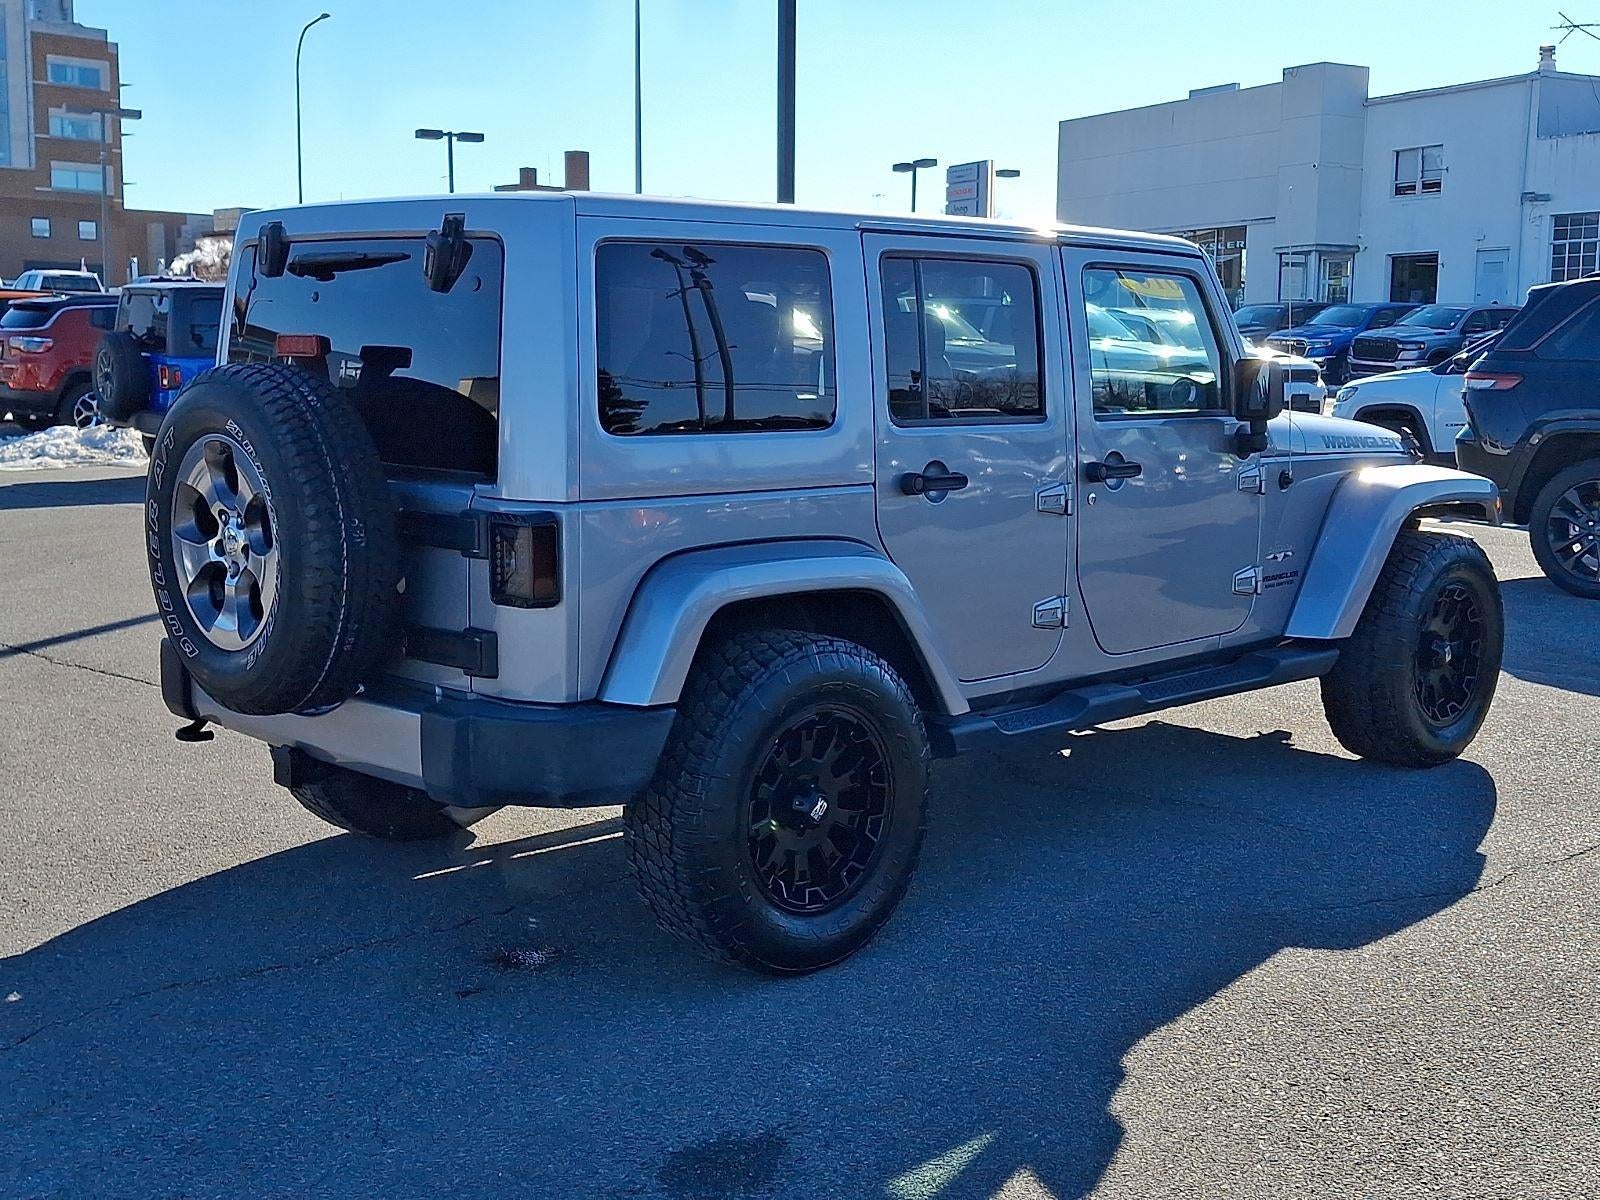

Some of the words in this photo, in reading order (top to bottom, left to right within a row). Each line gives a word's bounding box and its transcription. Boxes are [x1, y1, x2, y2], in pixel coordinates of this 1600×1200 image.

[1320, 435, 1401, 449] WRANGLER
[153, 425, 178, 492] A/T
[811, 797, 827, 815] XD
